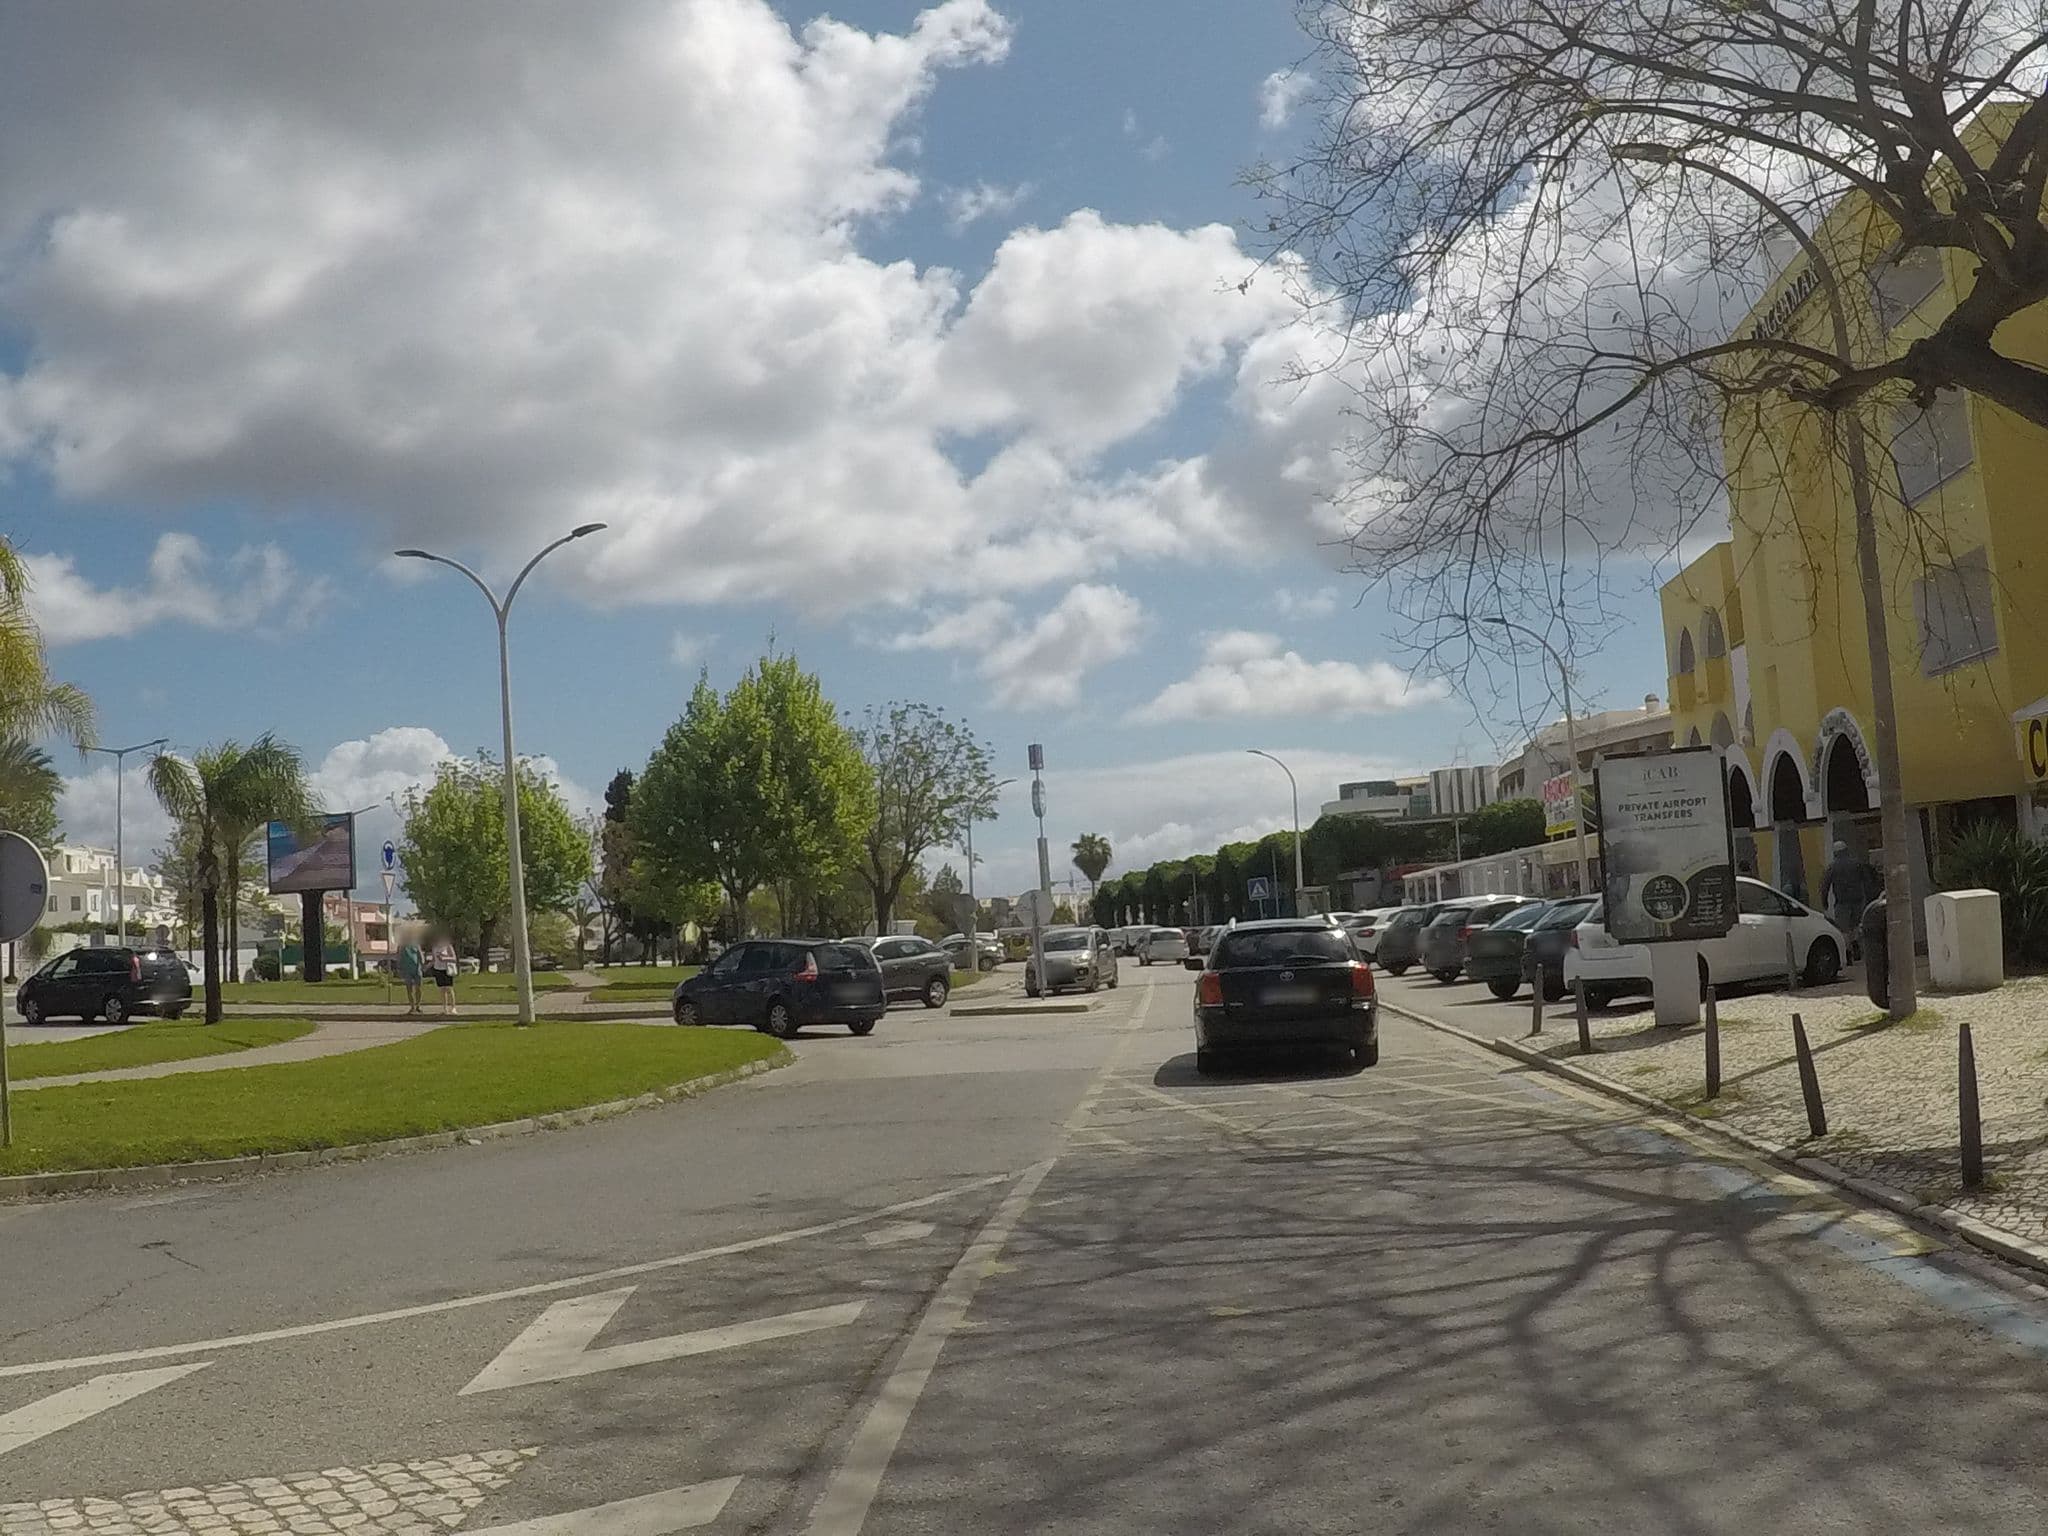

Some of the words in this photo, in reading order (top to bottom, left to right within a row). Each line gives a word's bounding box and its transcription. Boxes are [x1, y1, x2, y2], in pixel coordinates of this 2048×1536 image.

[1618, 801, 1660, 812] PRIVATE
[1663, 797, 1707, 809] AIRPORT
[1634, 810, 1693, 822] TRANSFERS
